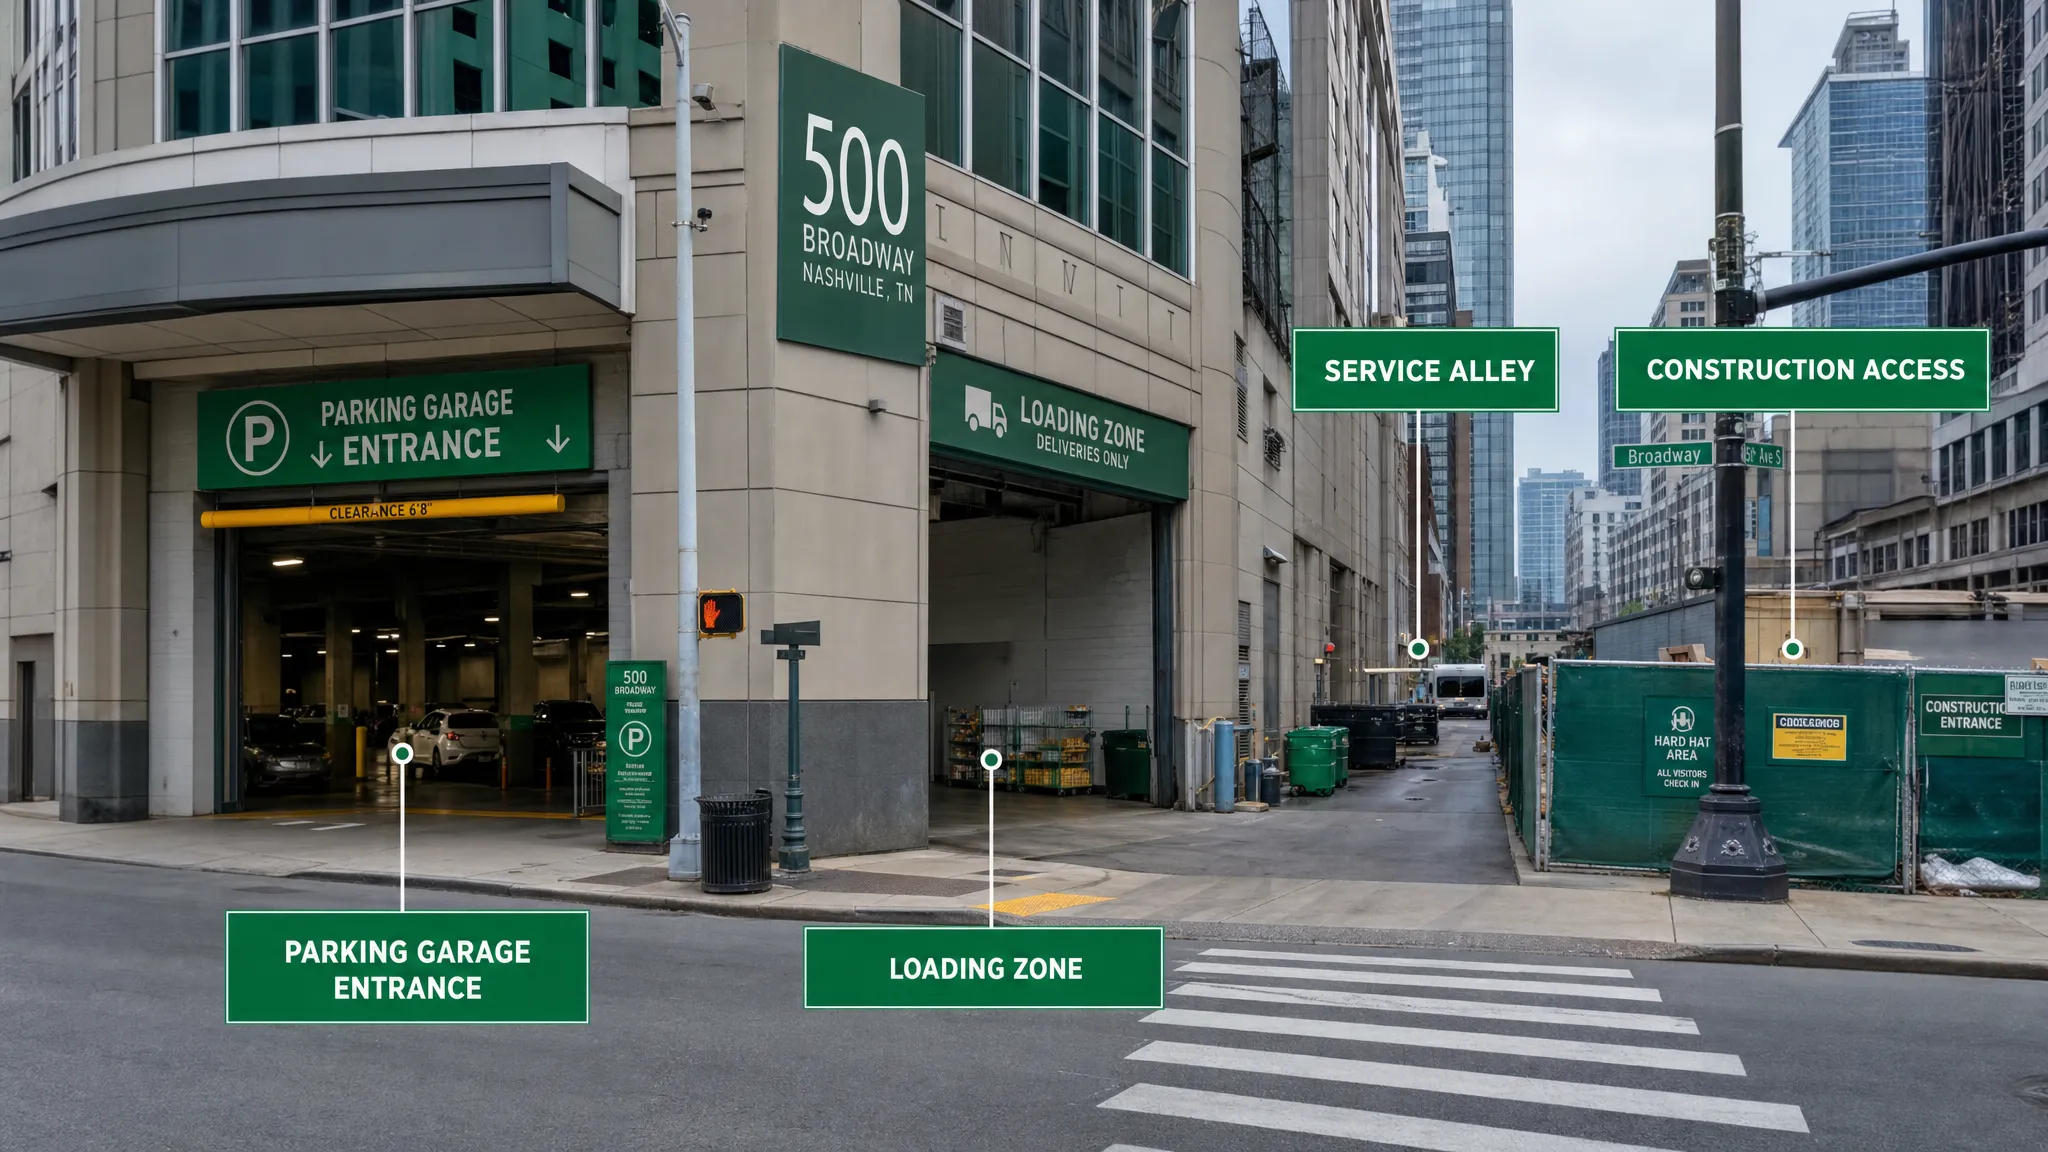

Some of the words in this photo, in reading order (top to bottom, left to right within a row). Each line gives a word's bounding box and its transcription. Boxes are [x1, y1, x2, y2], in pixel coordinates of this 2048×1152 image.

[803, 113, 909, 236] 500
[803, 223, 914, 276] BROADWAY
[803, 262, 890, 302] NASHVILLE,
[896, 282, 913, 304] TN
[321, 395, 417, 427] PARKING
[423, 388, 514, 420] GARAGE
[1020, 395, 1099, 441] LOADING
[1103, 419, 1145, 453] ZONE
[245, 415, 275, 462] P
[343, 427, 501, 466] ENTRANCE
[1036, 432, 1100, 463] DELIVERIES
[1103, 450, 1129, 470] ONLY
[1628, 448, 1701, 465] Broadway
[1759, 447, 1774, 464] Ave
[1775, 449, 1781, 465] S
[329, 504, 405, 520] CLEARANCE
[623, 670, 647, 684] 500
[614, 685, 657, 695] BROADWAY
[1925, 700, 2006, 714] CONSTRUCTIO
[1940, 716, 2002, 730] ENTRANCE
[628, 728, 644, 751] P
[1654, 735, 1686, 747] HARD
[1689, 736, 1712, 748] HAT
[1666, 749, 1698, 761] AREA
[1657, 768, 1671, 777] ALL
[1672, 769, 1707, 778] VISITORS
[1664, 779, 1689, 788] CHECK
[1691, 780, 1700, 788] IN
